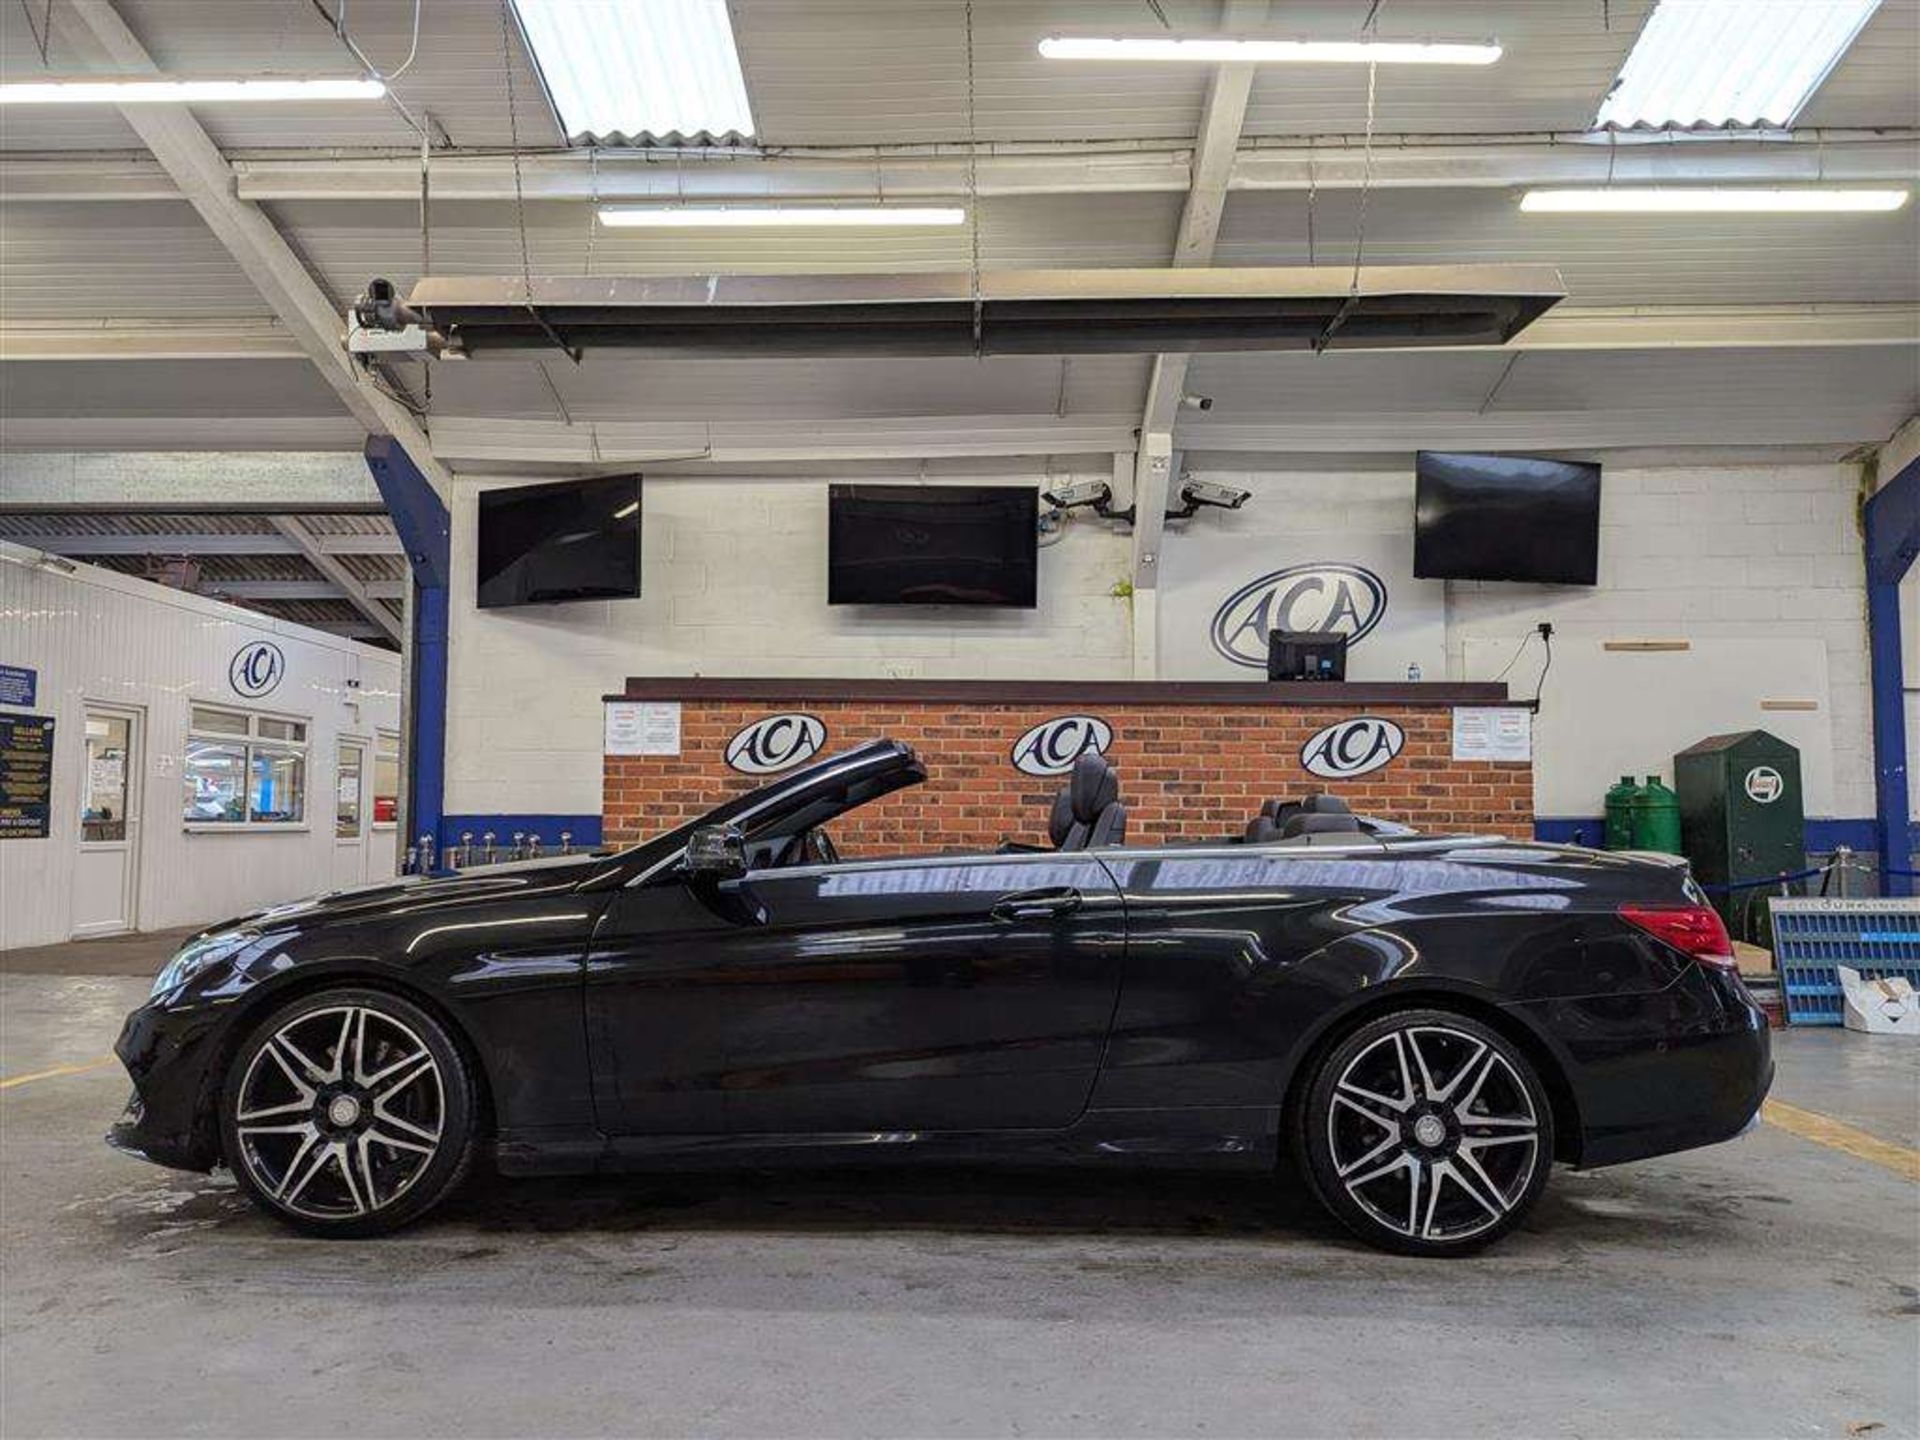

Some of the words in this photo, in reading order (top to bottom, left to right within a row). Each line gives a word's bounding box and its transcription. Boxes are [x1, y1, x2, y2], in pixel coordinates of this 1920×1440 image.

[1227, 576, 1361, 647] ACA
[233, 646, 281, 690] ACA
[728, 718, 817, 768] ACA
[1015, 720, 1102, 769] ACA
[1304, 722, 1394, 771] ACA
